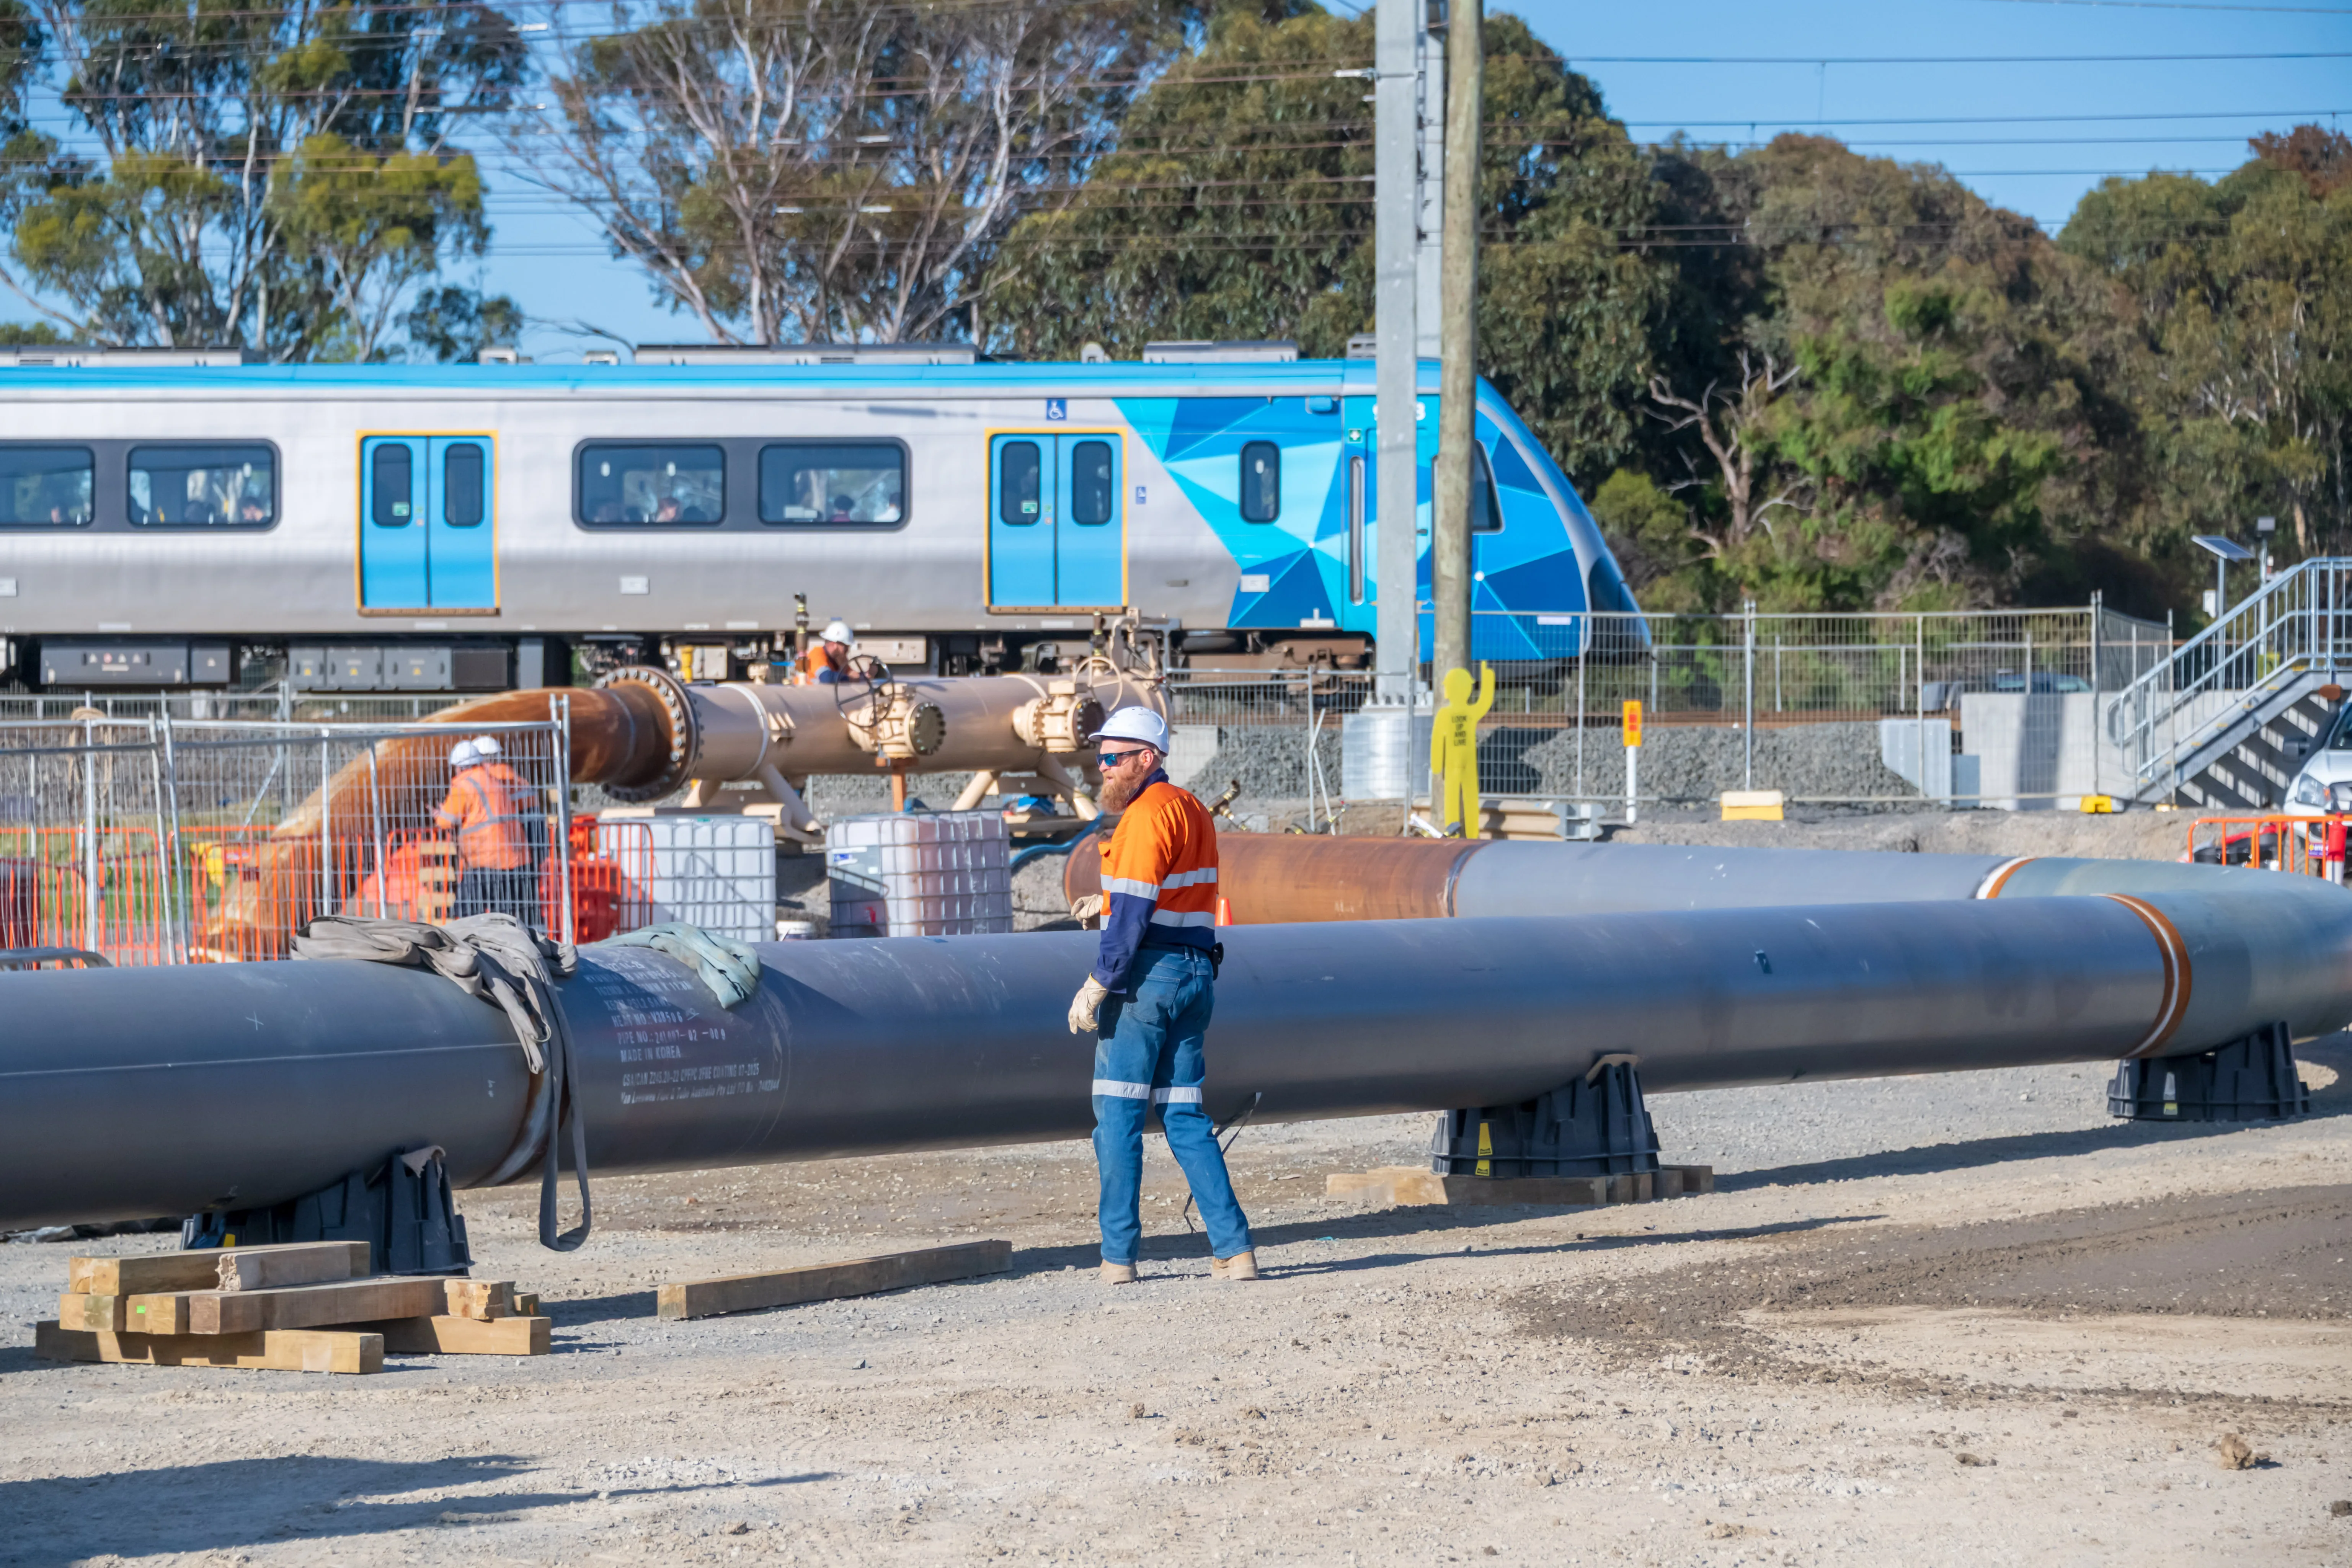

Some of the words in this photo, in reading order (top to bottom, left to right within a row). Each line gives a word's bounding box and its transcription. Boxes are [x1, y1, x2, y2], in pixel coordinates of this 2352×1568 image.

[617, 1031, 635, 1044] PIPE
[620, 1049, 642, 1062] MADE
[645, 1048, 653, 1060] IN
[655, 1045, 681, 1059] KOREA
[713, 1064, 737, 1079] COATING
